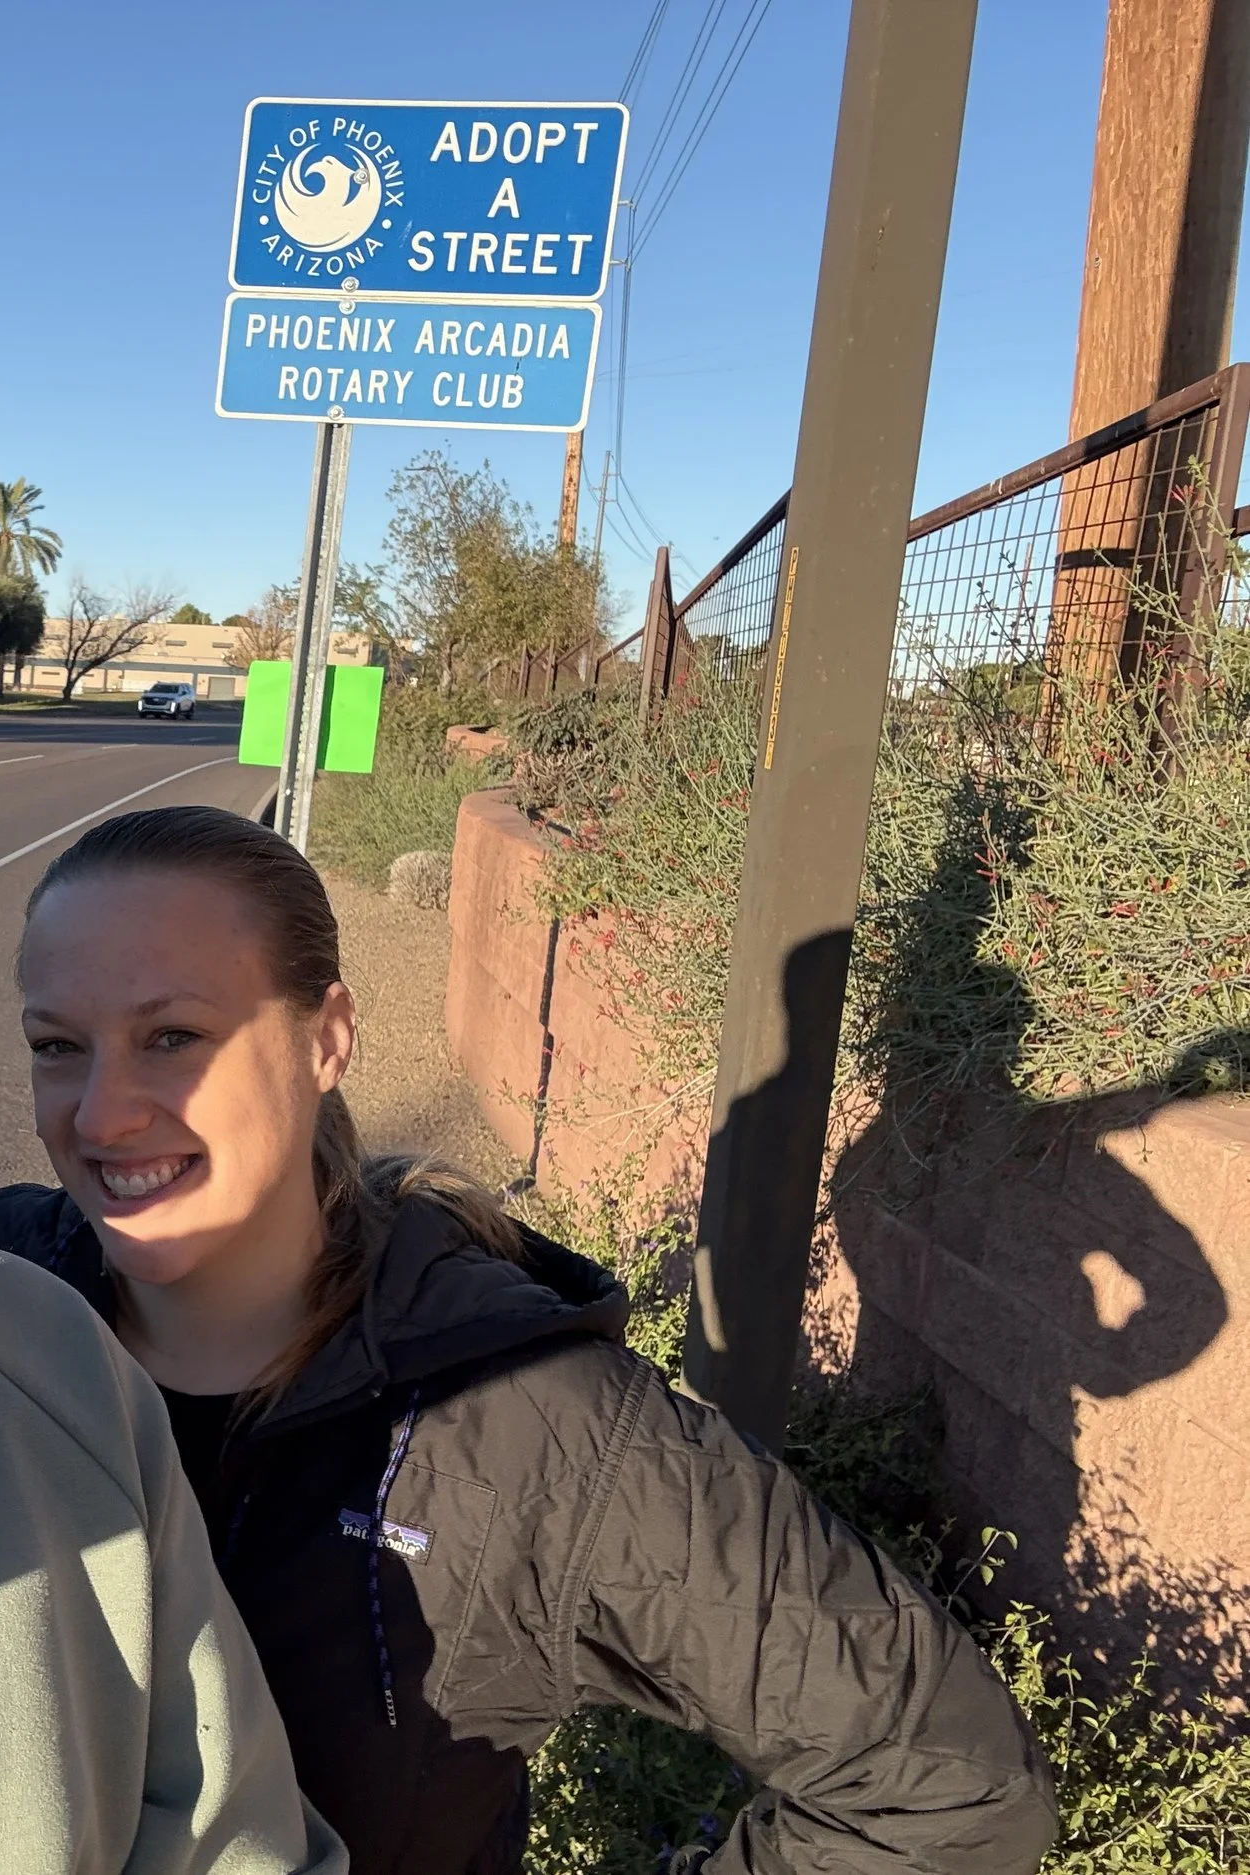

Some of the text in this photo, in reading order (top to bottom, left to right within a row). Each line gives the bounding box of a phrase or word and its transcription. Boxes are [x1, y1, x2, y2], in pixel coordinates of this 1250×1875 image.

[252, 117, 405, 207] CITY OF PHOENIX
[430, 121, 599, 164] ADOPT
[487, 177, 520, 219] A
[261, 234, 384, 277] ARIZONA
[407, 231, 592, 275] STREET
[245, 314, 570, 360] PHOENIX ARCADIA
[278, 366, 525, 409] ROTARY CLUB
[342, 1524, 417, 1556] patgonia
